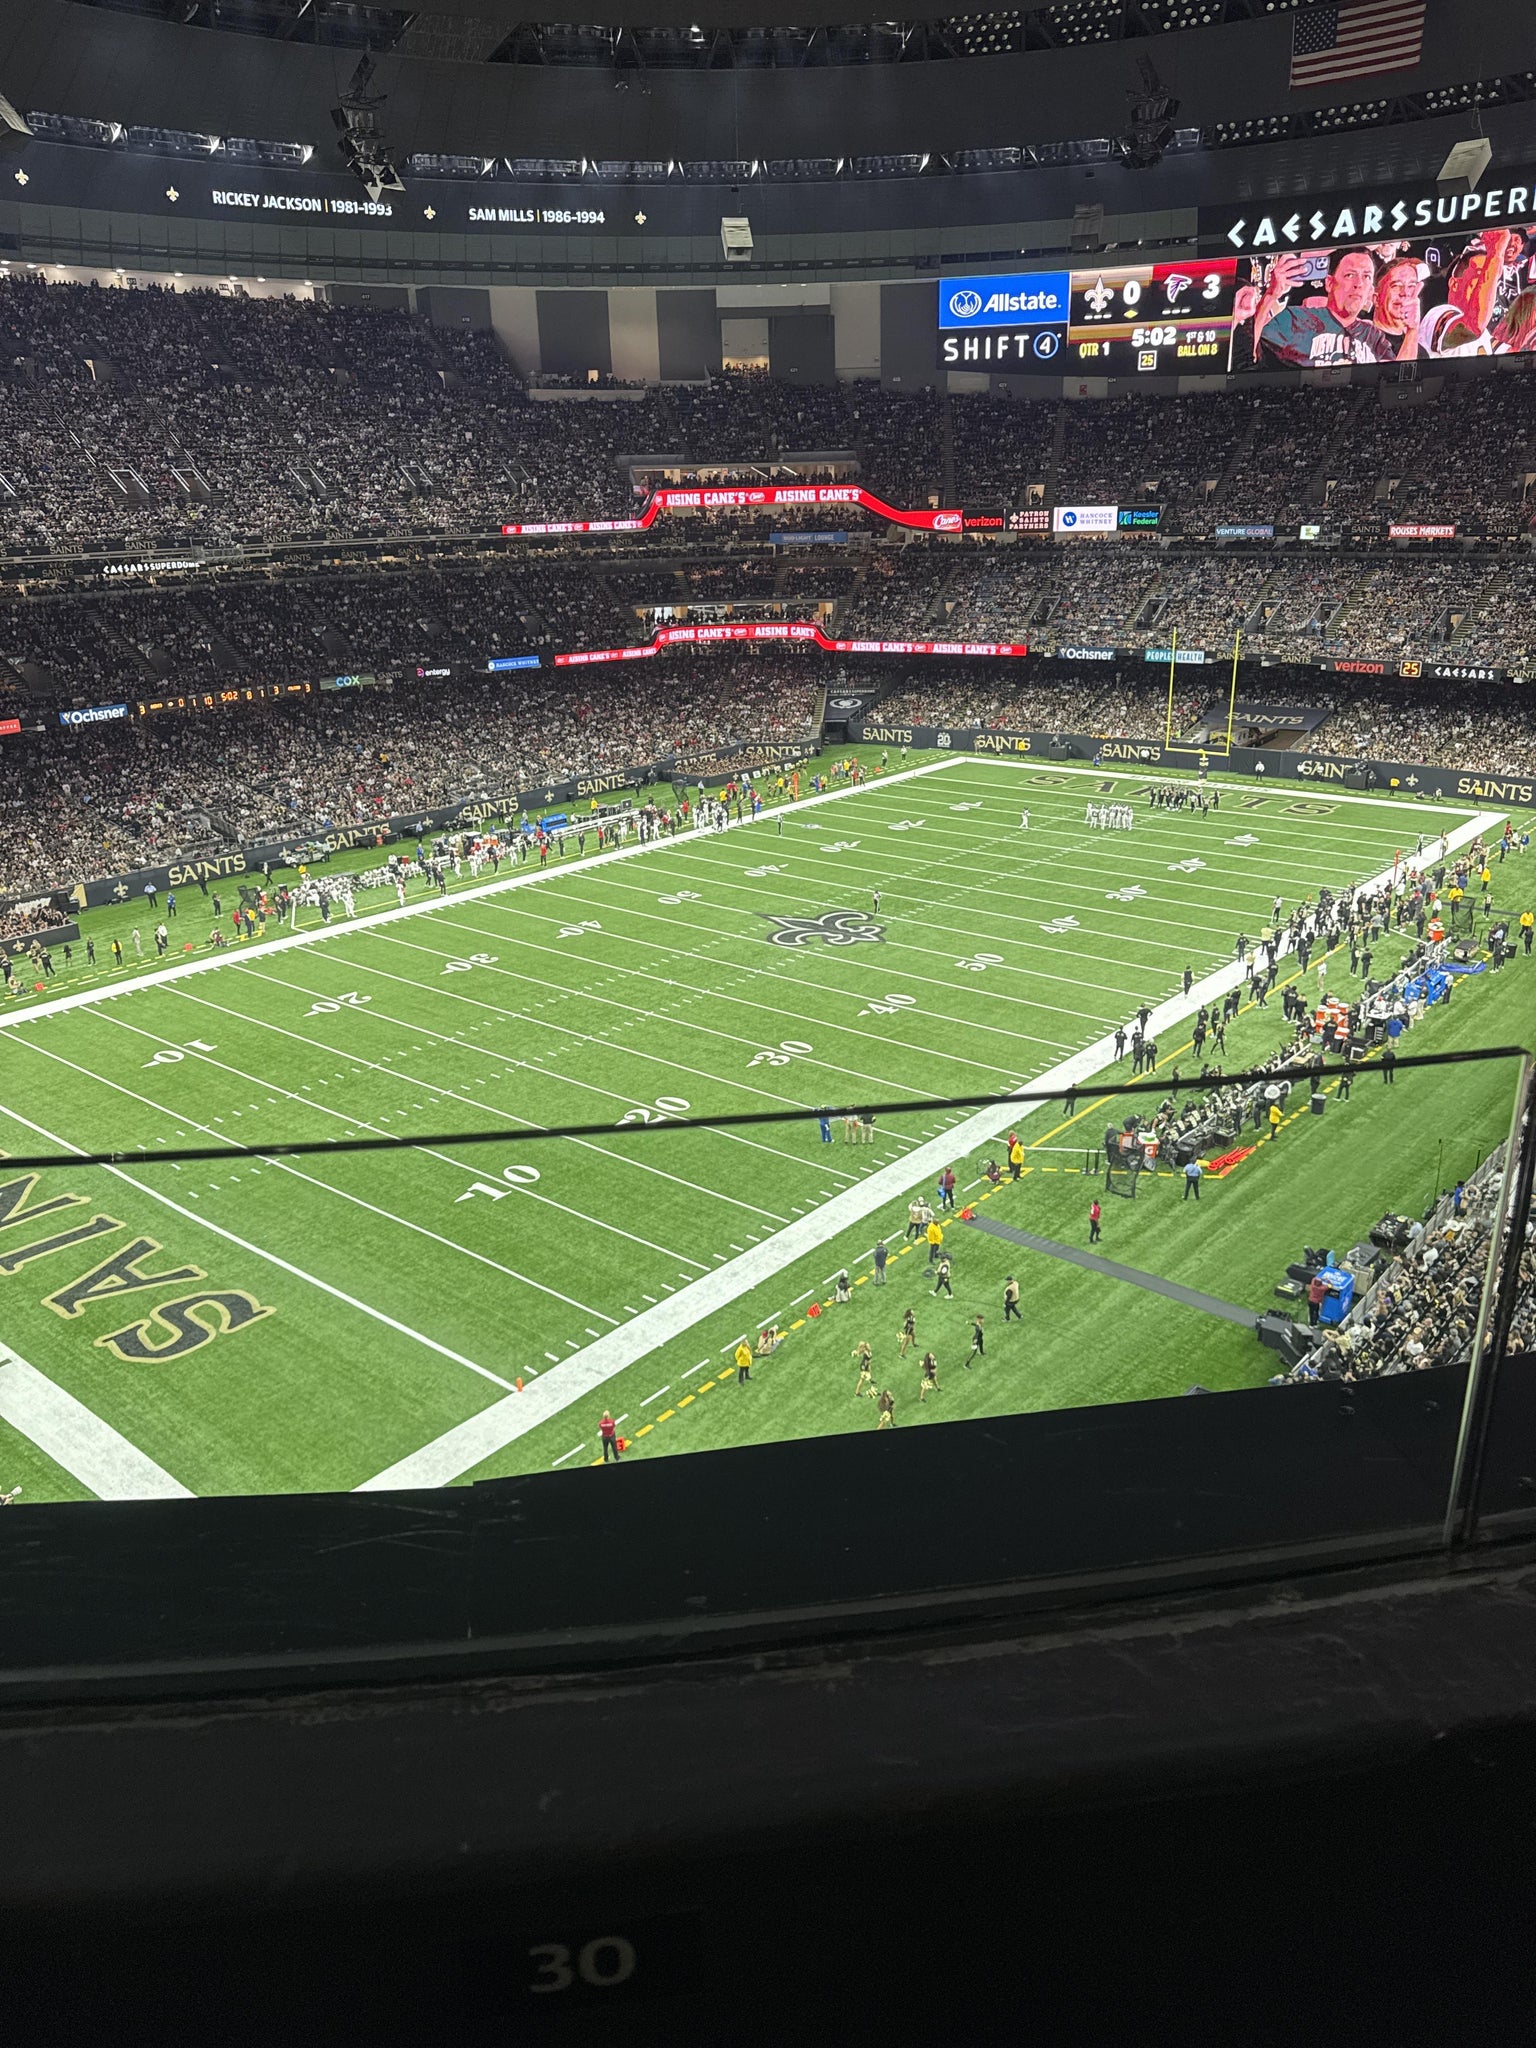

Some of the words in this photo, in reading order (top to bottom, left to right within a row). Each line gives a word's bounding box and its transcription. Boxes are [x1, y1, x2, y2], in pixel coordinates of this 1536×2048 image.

[212, 190, 260, 207] RICKEY
[262, 195, 322, 212] JACKSON
[330, 199, 393, 217] 1981-1993
[468, 208, 496, 222] SAM
[498, 208, 535, 223] MILLS
[542, 210, 606, 224] 1986-1994
[1226, 200, 1408, 248] CAESARS
[1414, 184, 1536, 226] SUPER
[1122, 280, 1141, 305] 0
[1202, 273, 1221, 300] 3
[983, 291, 1058, 313] Allstate
[1131, 326, 1177, 348] 5:02
[1079, 342, 1099, 358] QTR
[1102, 341, 1111, 356] 1
[1177, 345, 1198, 357] BALL
[1198, 344, 1210, 355] ON
[1210, 343, 1218, 355] 8
[1141, 355, 1154, 366] 25
[704, 492, 746, 505] CANE'S
[819, 489, 860, 501] CANE'S
[964, 515, 1003, 527] verizon
[1019, 510, 1050, 518] PATRON
[1132, 511, 1160, 519] Keesler
[1008, 522, 1050, 530] PARTNERS
[1351, 525, 1381, 534] SAINTS
[1390, 526, 1418, 536] ROUSES
[1419, 526, 1455, 536] MARKETS
[1487, 524, 1519, 534] SAINTS
[262, 534, 292, 543] SAINTS
[814, 533, 835, 541] LOUNGE
[50, 545, 84, 555] SAINTS
[124, 541, 158, 551] SAINTS
[103, 563, 150, 574] CAESARS
[1066, 648, 1114, 661] Ochsner
[1176, 651, 1203, 661] HEALTH
[1280, 655, 1311, 664] SAINTS
[425, 668, 451, 678] entergy
[1334, 661, 1385, 674] verizon
[1402, 662, 1419, 675] 25
[1434, 666, 1495, 680] CAESARS
[1507, 669, 1536, 679] SAINT
[335, 676, 361, 687] COX
[71, 706, 126, 724] Ochsner
[1224, 712, 1305, 726] SAINTS
[863, 727, 913, 743] SAINTS
[576, 773, 626, 797] SAINTS
[1458, 777, 1533, 803] SAINTS
[462, 796, 519, 820] SAINTS
[168, 853, 246, 887] SAINTS
[1167, 857, 1207, 874] 20
[657, 890, 702, 905] 50
[1105, 885, 1147, 902] 30
[560, 919, 602, 937] 40
[1039, 916, 1081, 935] 40
[444, 952, 500, 972] 30
[954, 952, 1005, 972] 50
[311, 990, 373, 1014] 20
[867, 993, 917, 1016] 40
[153, 1038, 219, 1064] 10
[753, 1040, 814, 1066] 30
[623, 1096, 691, 1124] 20
[466, 1164, 541, 1202] 10
[528, 1935, 638, 1994] 30
